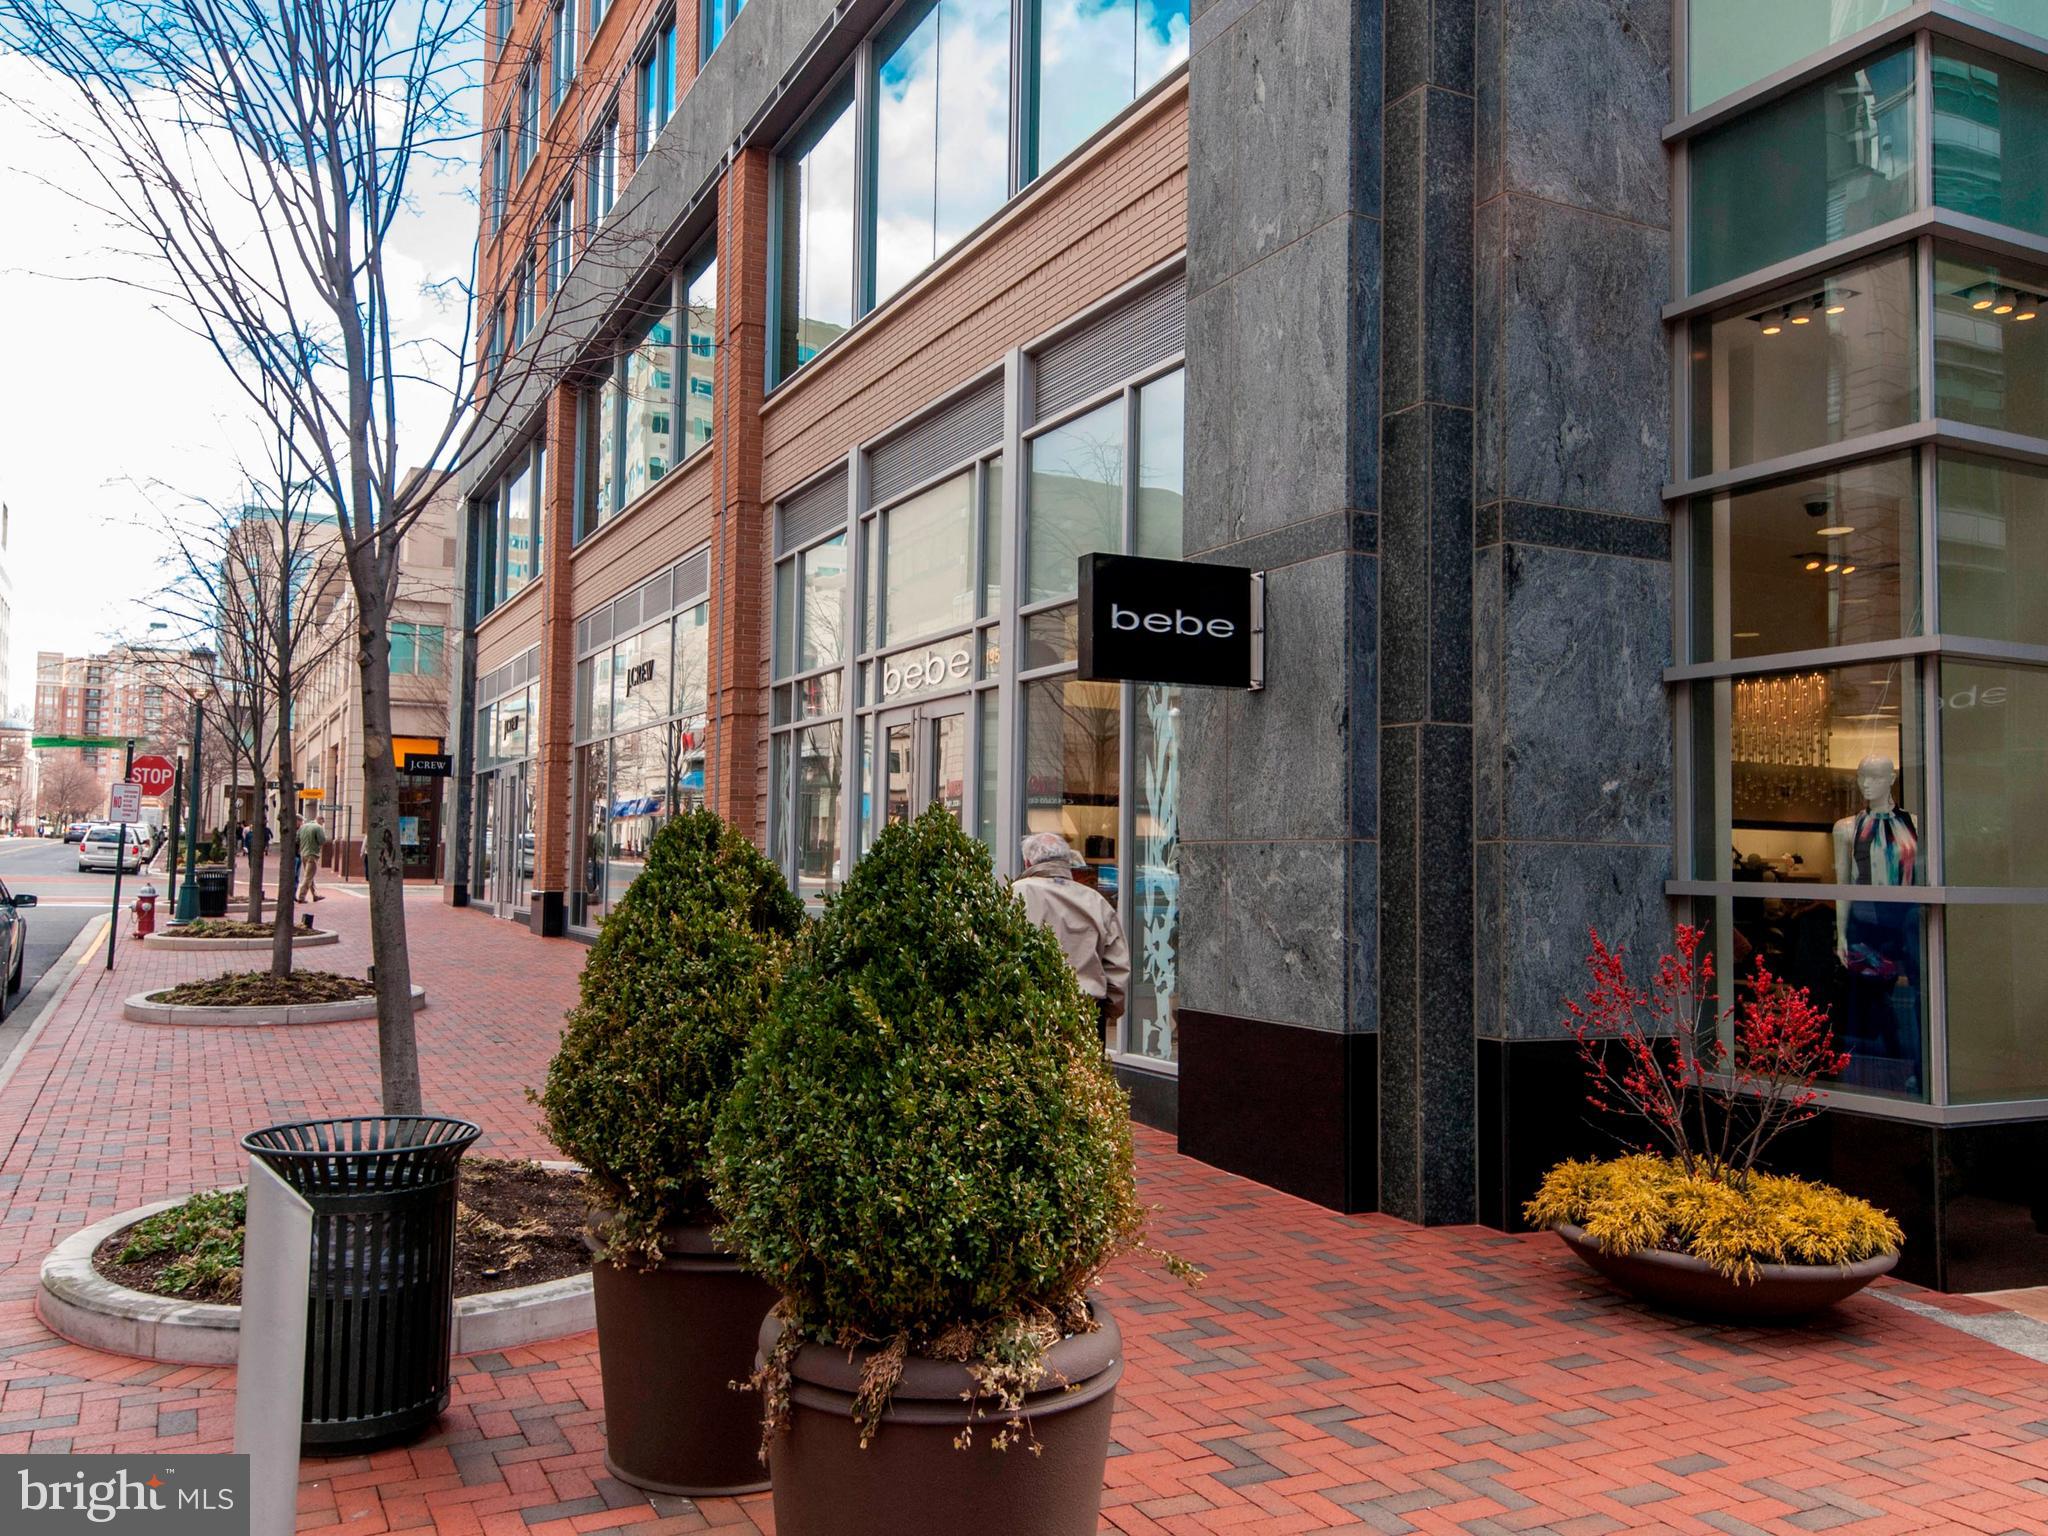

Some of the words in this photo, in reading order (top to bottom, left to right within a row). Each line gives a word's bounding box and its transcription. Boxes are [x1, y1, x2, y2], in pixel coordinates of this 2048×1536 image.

[1111, 603, 1235, 638] bebe
[883, 649, 970, 696] bebe
[131, 767, 172, 785] STOP
[410, 759, 446, 771] J.CREW
